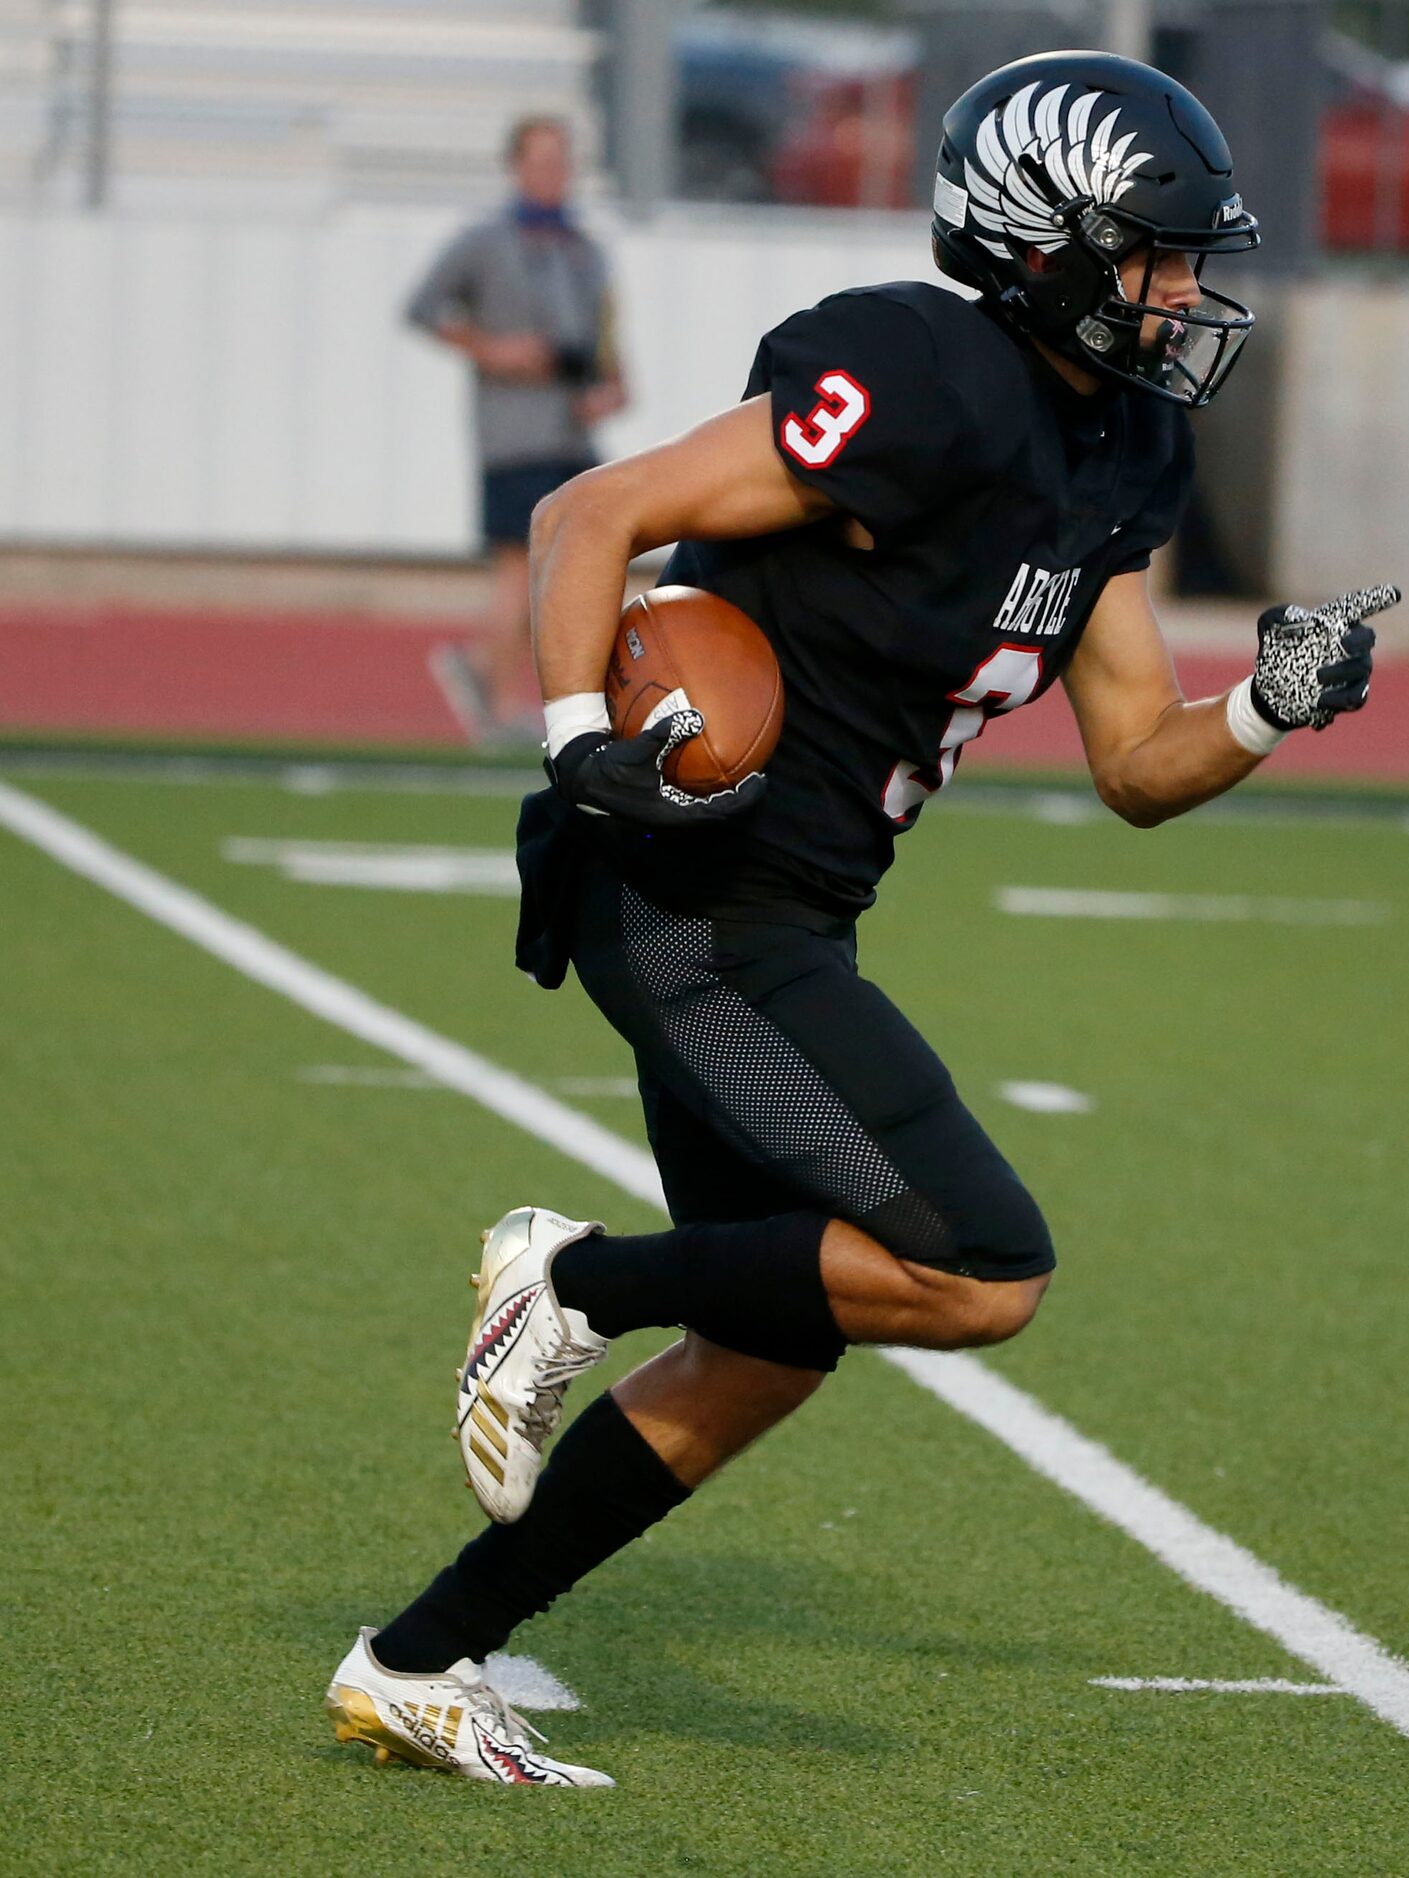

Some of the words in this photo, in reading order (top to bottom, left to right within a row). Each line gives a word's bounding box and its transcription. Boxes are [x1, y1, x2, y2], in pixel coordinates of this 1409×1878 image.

[780, 369, 870, 469] 3
[993, 562, 1081, 635] ARGYLE
[881, 642, 1044, 823] 3
[389, 1702, 462, 1769] adidas
